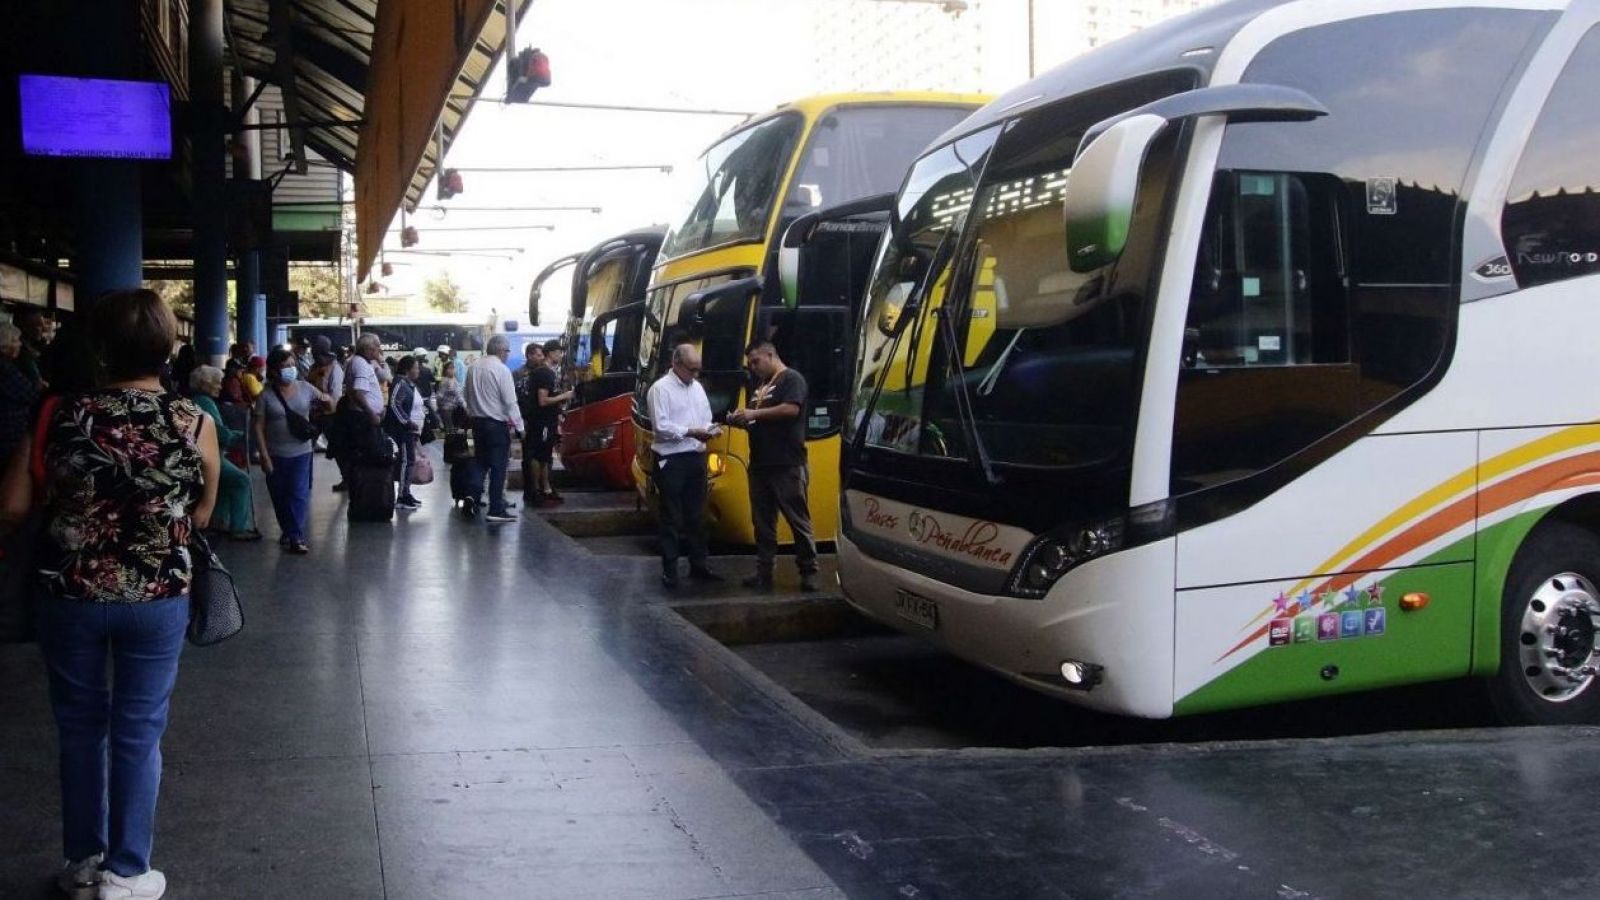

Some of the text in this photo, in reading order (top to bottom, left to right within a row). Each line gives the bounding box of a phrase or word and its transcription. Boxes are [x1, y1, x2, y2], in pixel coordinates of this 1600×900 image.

[1485, 263, 1511, 275] 360
[864, 497, 1012, 565] Buses Peñablanca
